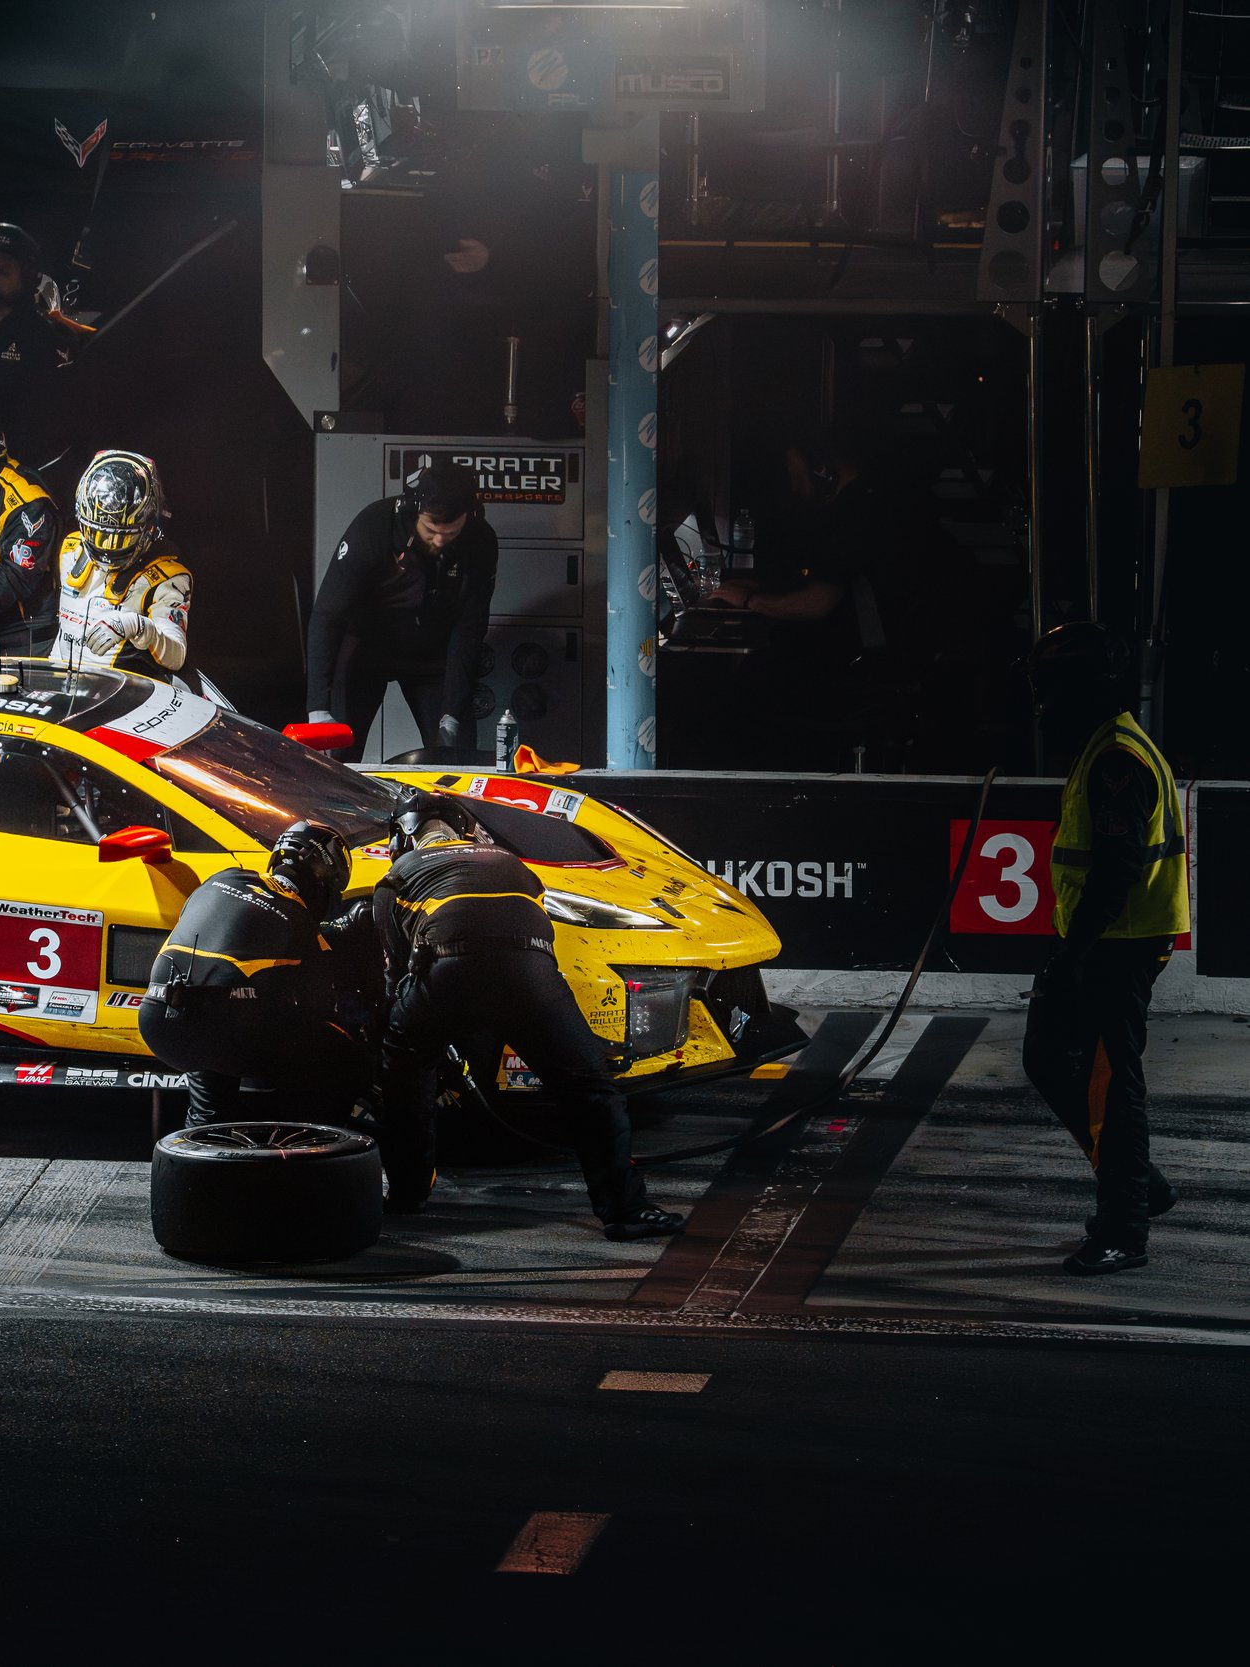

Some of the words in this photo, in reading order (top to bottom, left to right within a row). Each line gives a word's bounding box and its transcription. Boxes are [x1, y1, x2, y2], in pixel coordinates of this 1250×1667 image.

[112, 140, 245, 149] CORVETTE
[1178, 399, 1203, 449] 3
[453, 456, 562, 473] PRATT
[478, 474, 562, 491] ILLER
[475, 492, 563, 502] TORSPORTS
[12, 544, 33, 566] VP
[978, 833, 1039, 923] 3
[211, 881, 243, 894] PRATT
[26, 927, 62, 980] 3
[590, 1010, 625, 1018] PRATT
[590, 1017, 625, 1025] MILLER
[17, 1074, 50, 1084] HAAS
[127, 1071, 189, 1088] CiNTA
